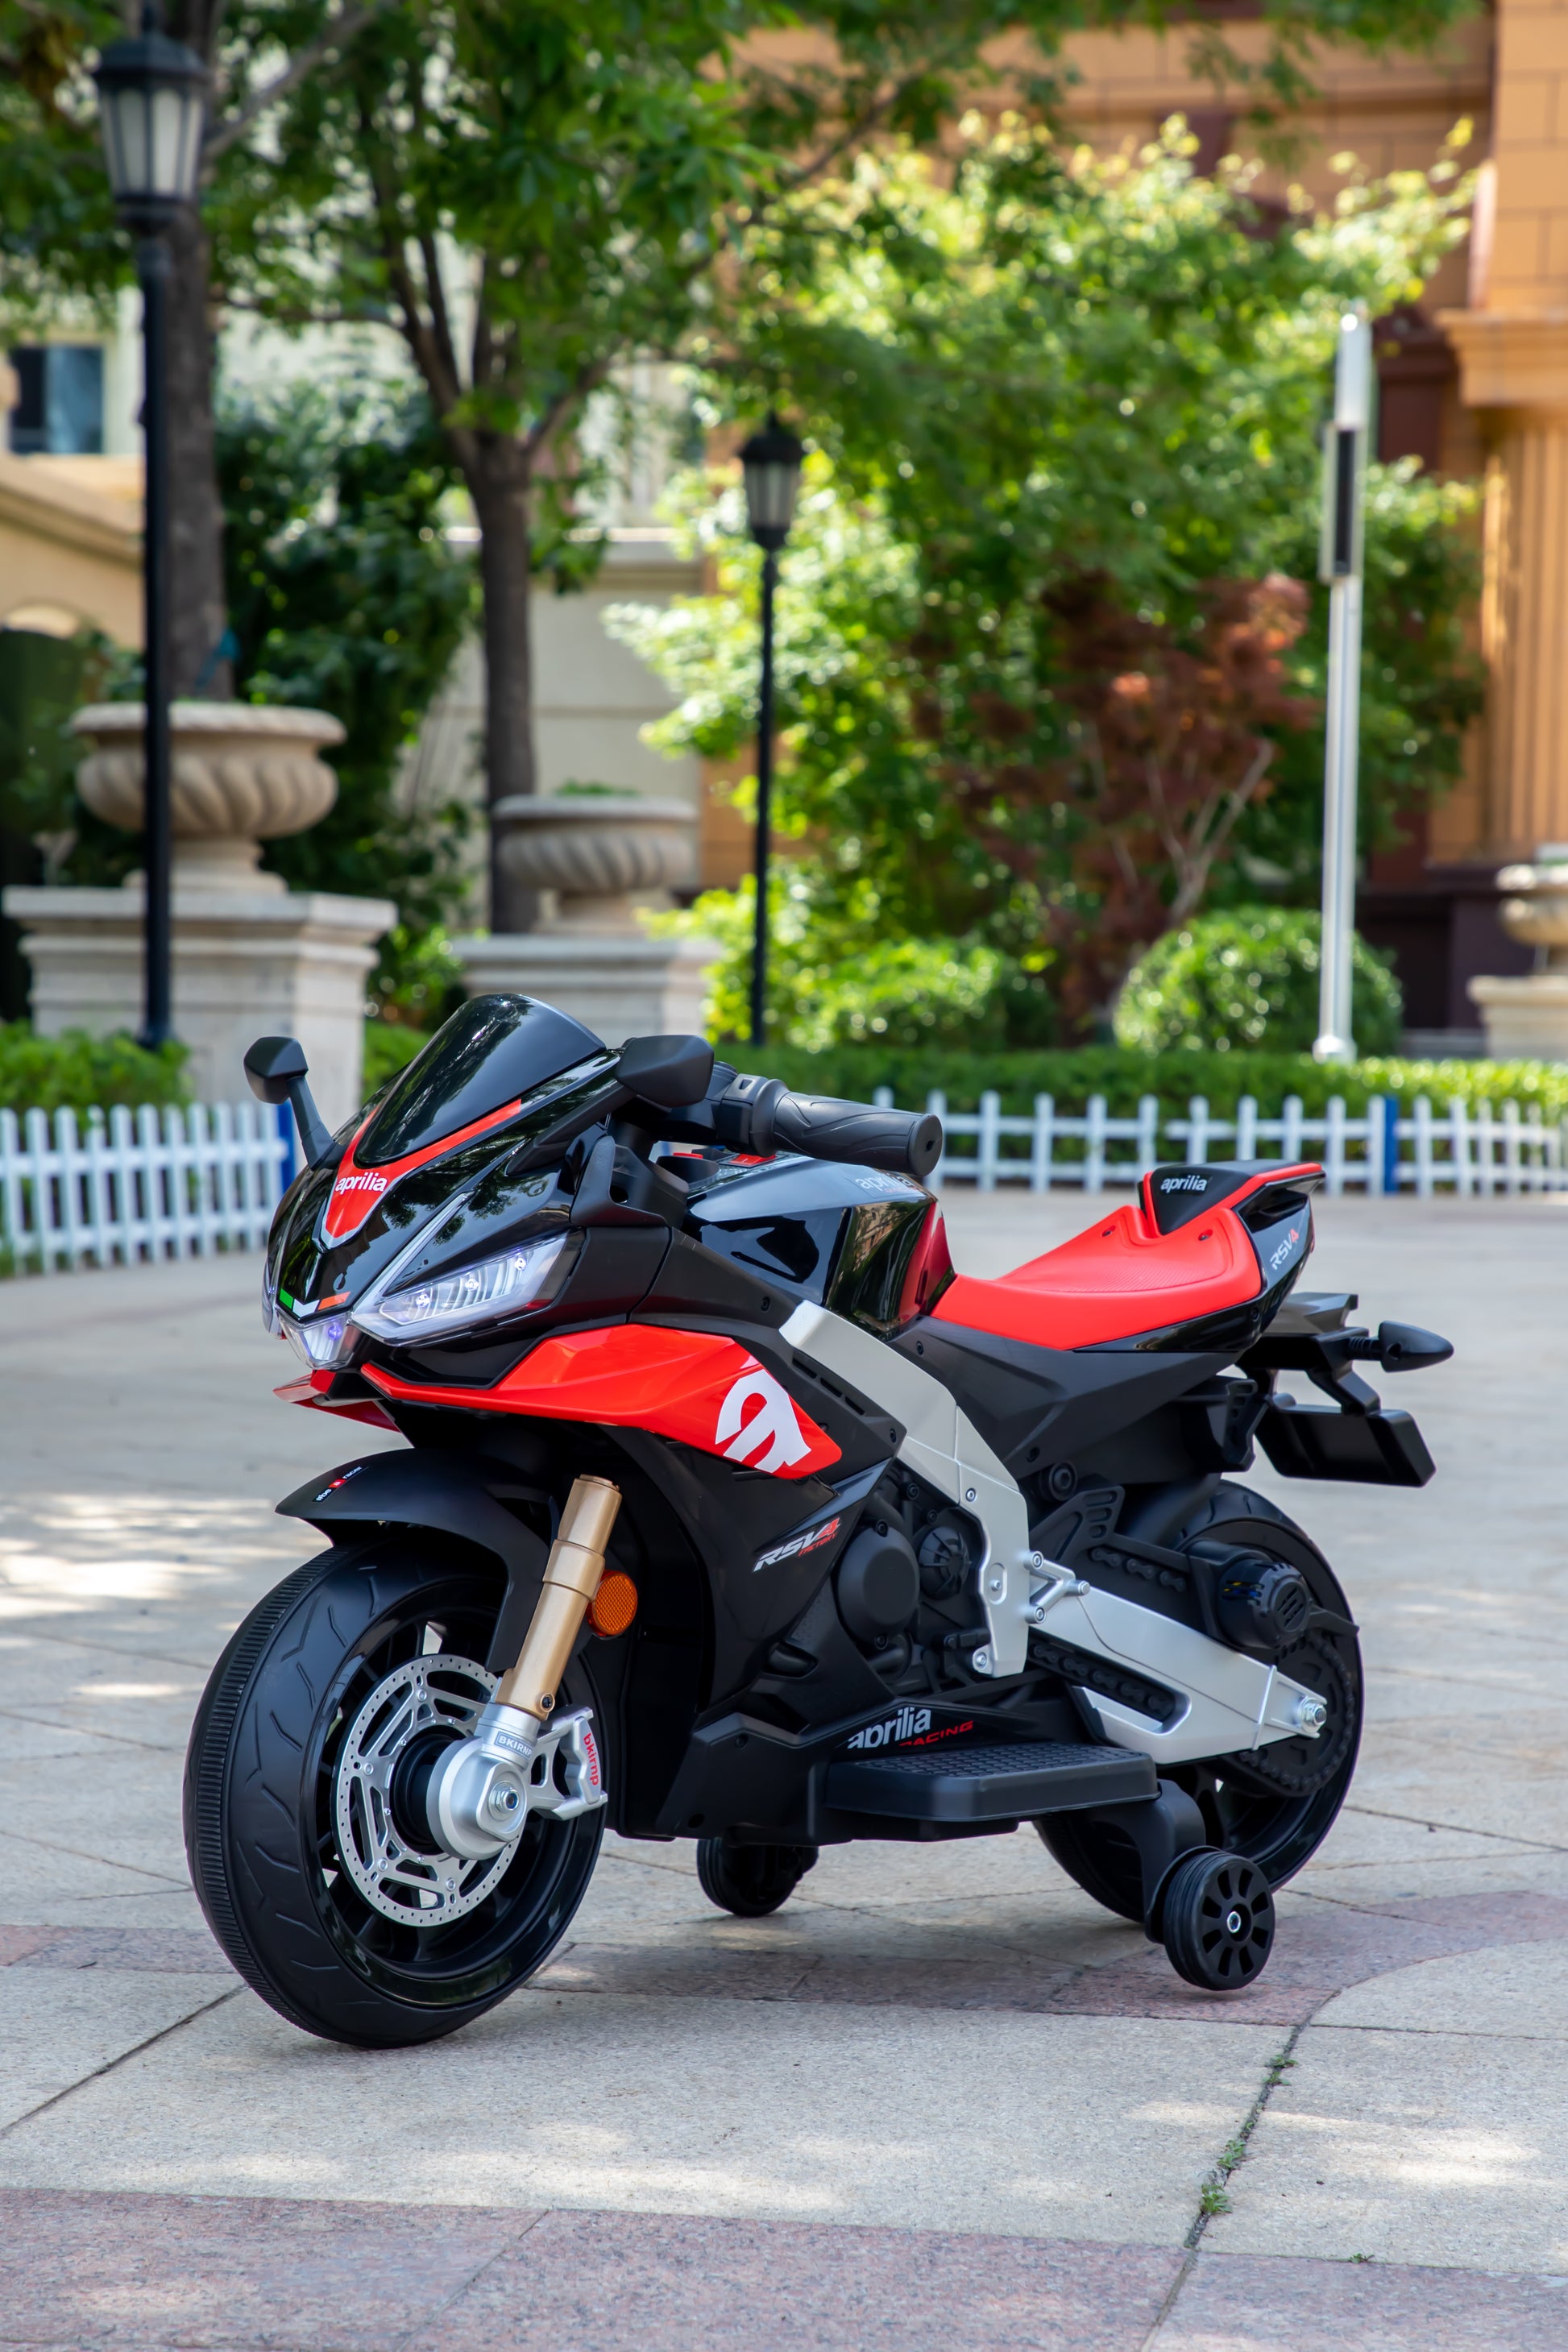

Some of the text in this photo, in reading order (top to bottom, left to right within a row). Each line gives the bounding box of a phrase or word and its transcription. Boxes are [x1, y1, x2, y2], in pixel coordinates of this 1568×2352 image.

[335, 1172, 388, 1195] aprilia
[1160, 1175, 1208, 1193] aprilia
[1270, 1228, 1300, 1271] RSV4
[753, 1516, 841, 1573] RSV4
[583, 1732, 600, 1786] bkirnp
